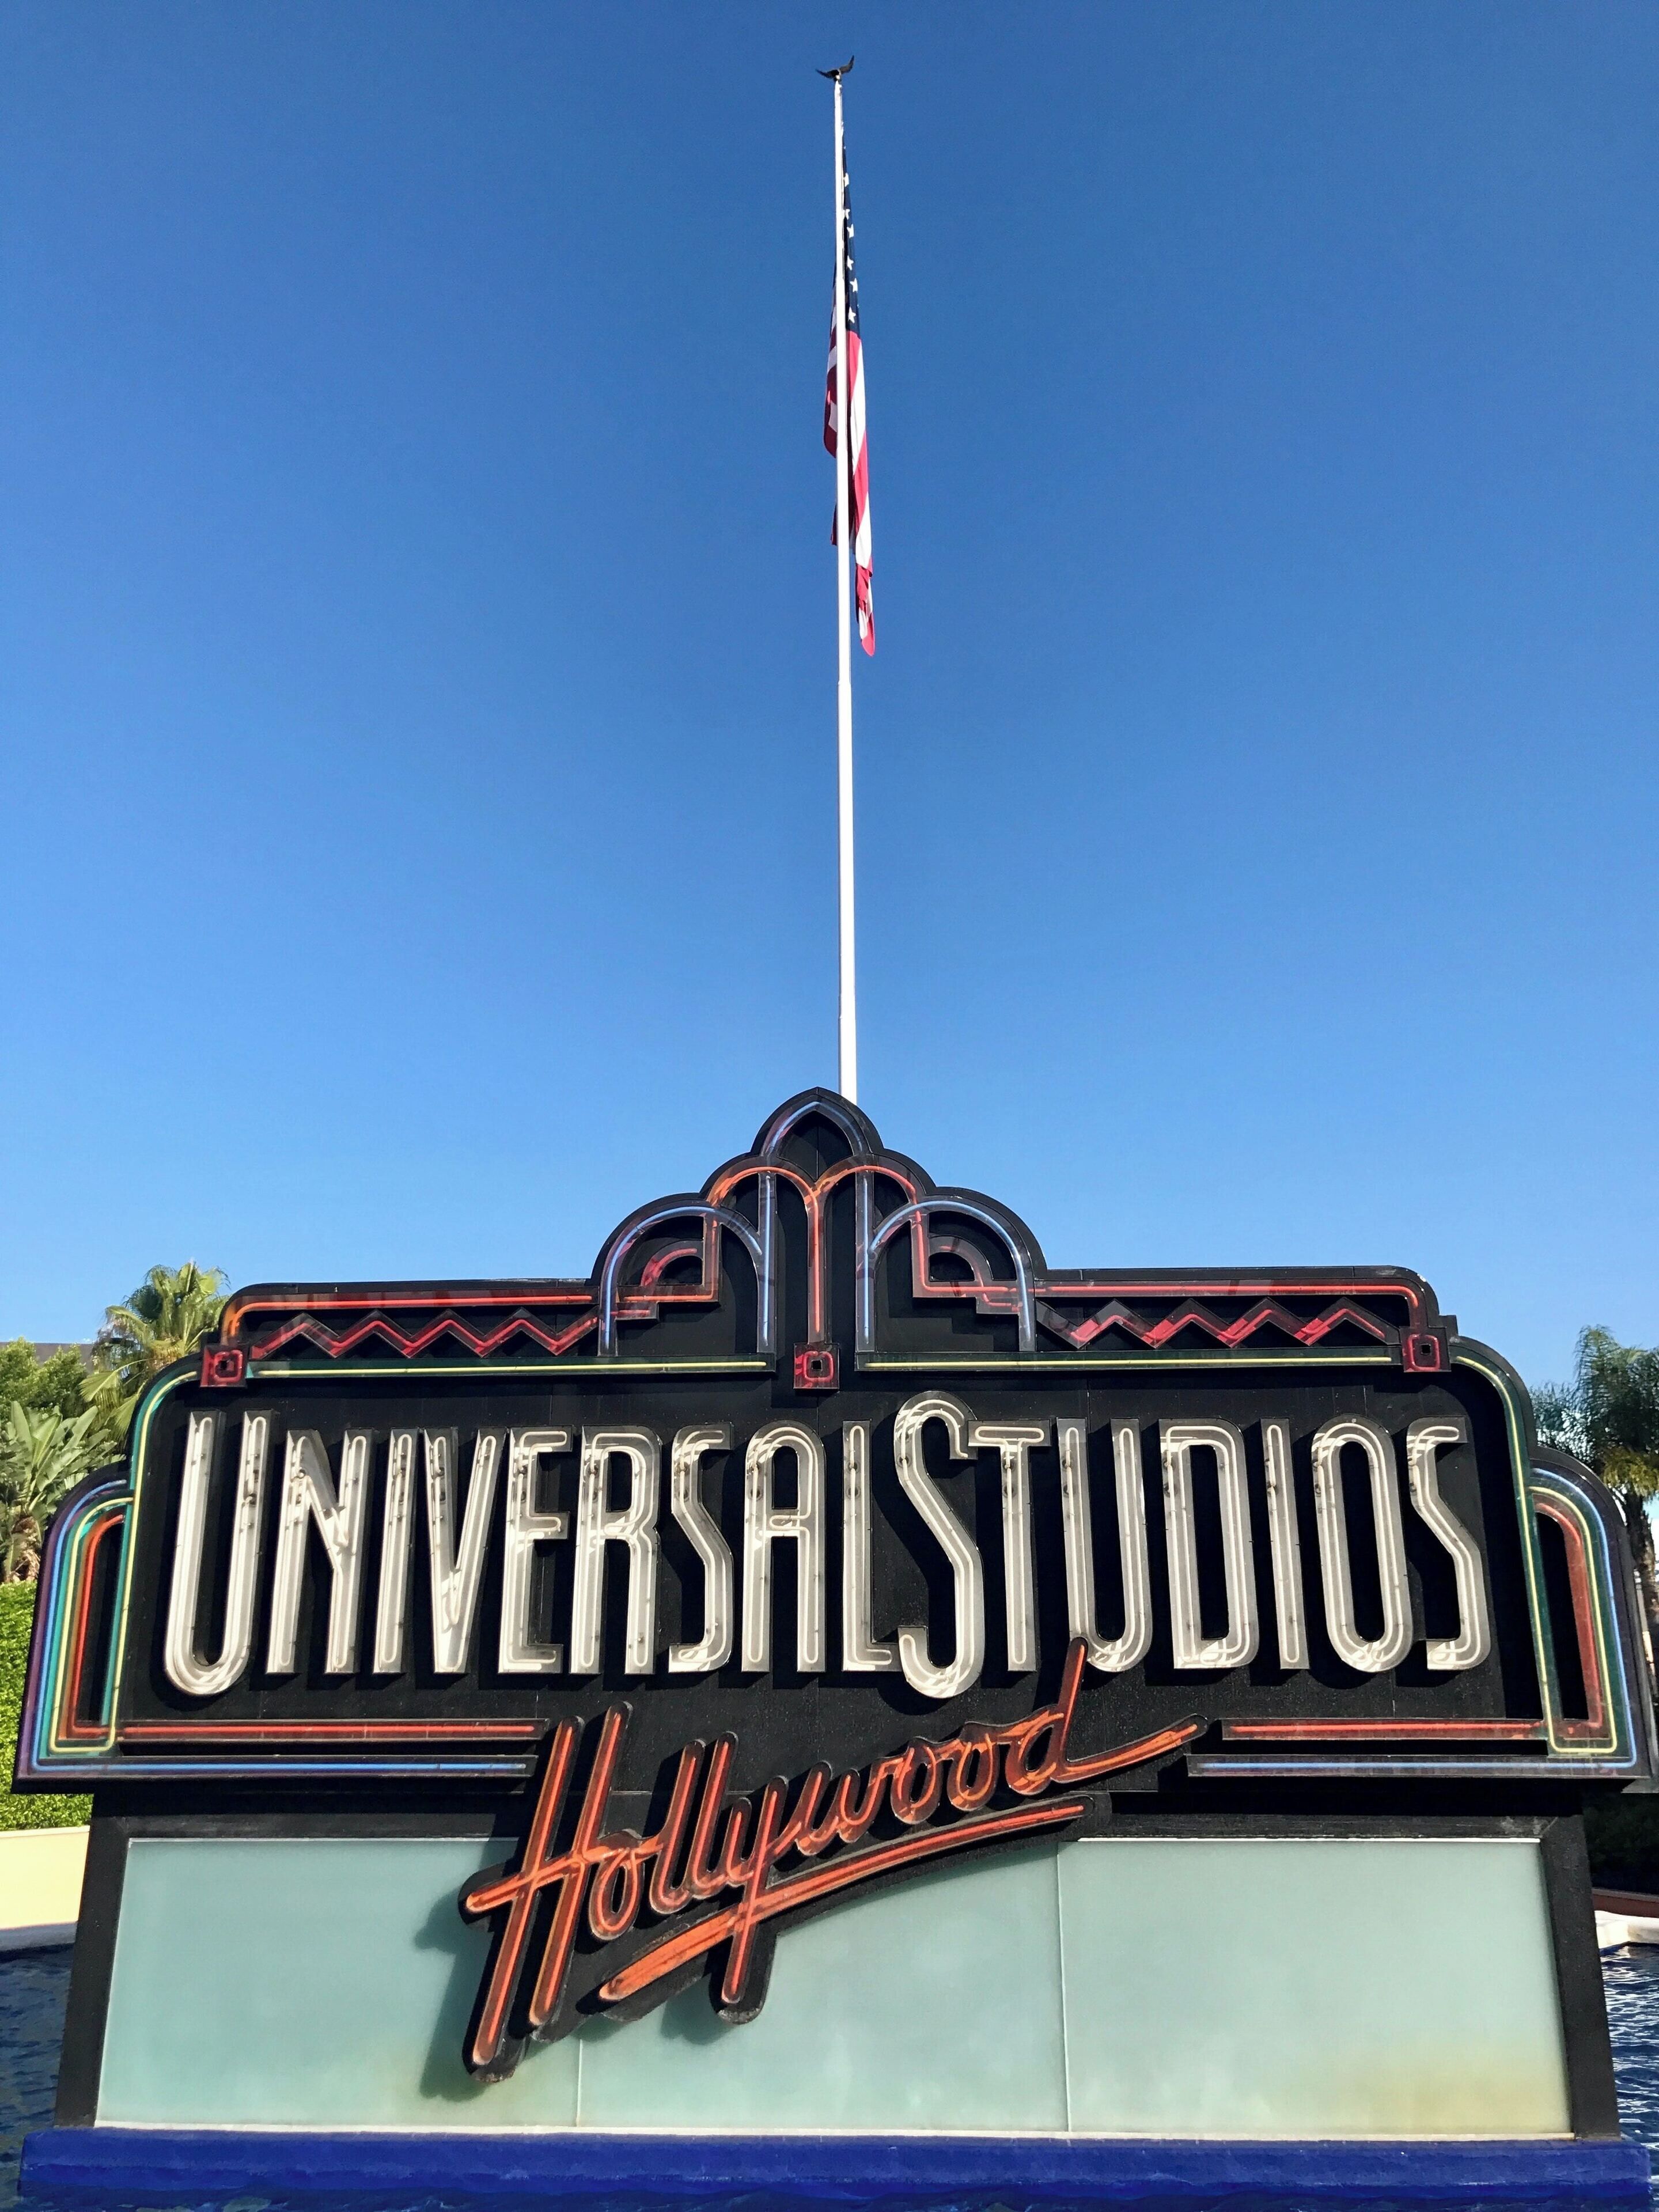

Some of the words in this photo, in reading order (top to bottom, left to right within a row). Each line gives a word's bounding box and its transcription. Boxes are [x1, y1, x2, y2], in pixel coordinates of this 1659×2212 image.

[164, 1409, 900, 1697] UNIVERSAL
[894, 1389, 1491, 1699] STUDIOS
[464, 1637, 1209, 2070] Hollywood
